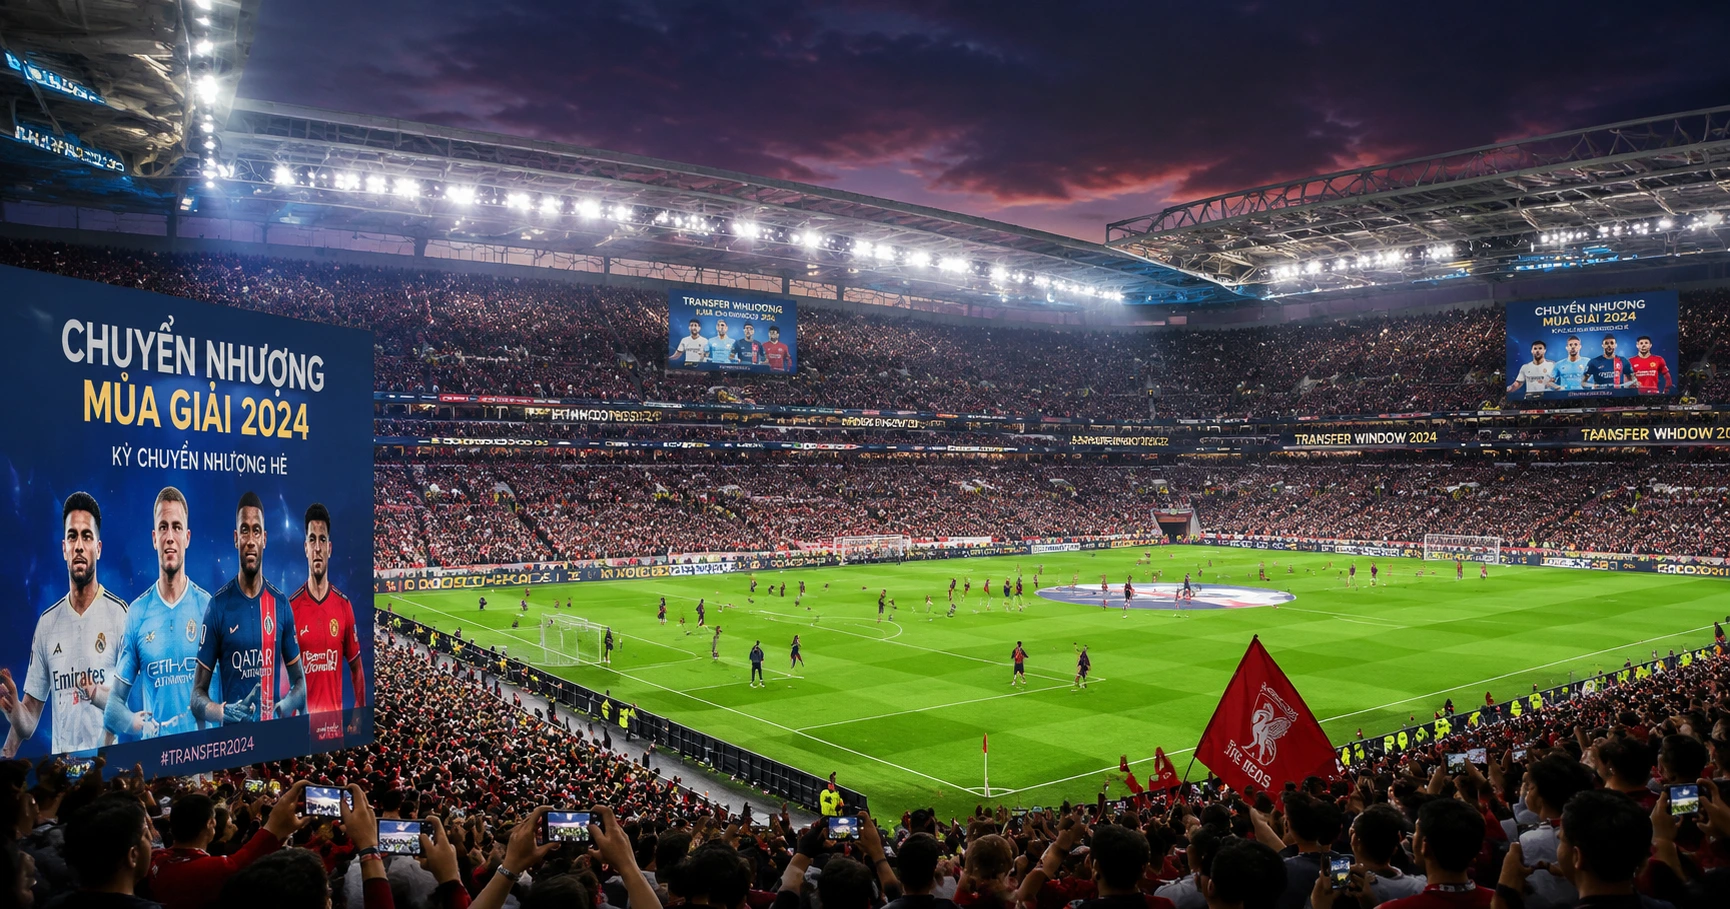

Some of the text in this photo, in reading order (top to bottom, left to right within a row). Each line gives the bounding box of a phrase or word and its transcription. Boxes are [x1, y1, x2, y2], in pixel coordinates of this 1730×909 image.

[682, 296, 730, 309] TRANSFER
[1603, 311, 1637, 323] 2024
[61, 314, 325, 397] CHUYỂN NHƯỢNG
[241, 397, 309, 440] 2024
[1294, 431, 1438, 445] TRANSFER WINDOW 2024
[231, 648, 272, 672] QATAR
[52, 666, 105, 691] Emirates
[160, 735, 255, 767] #TRANSFER2024
